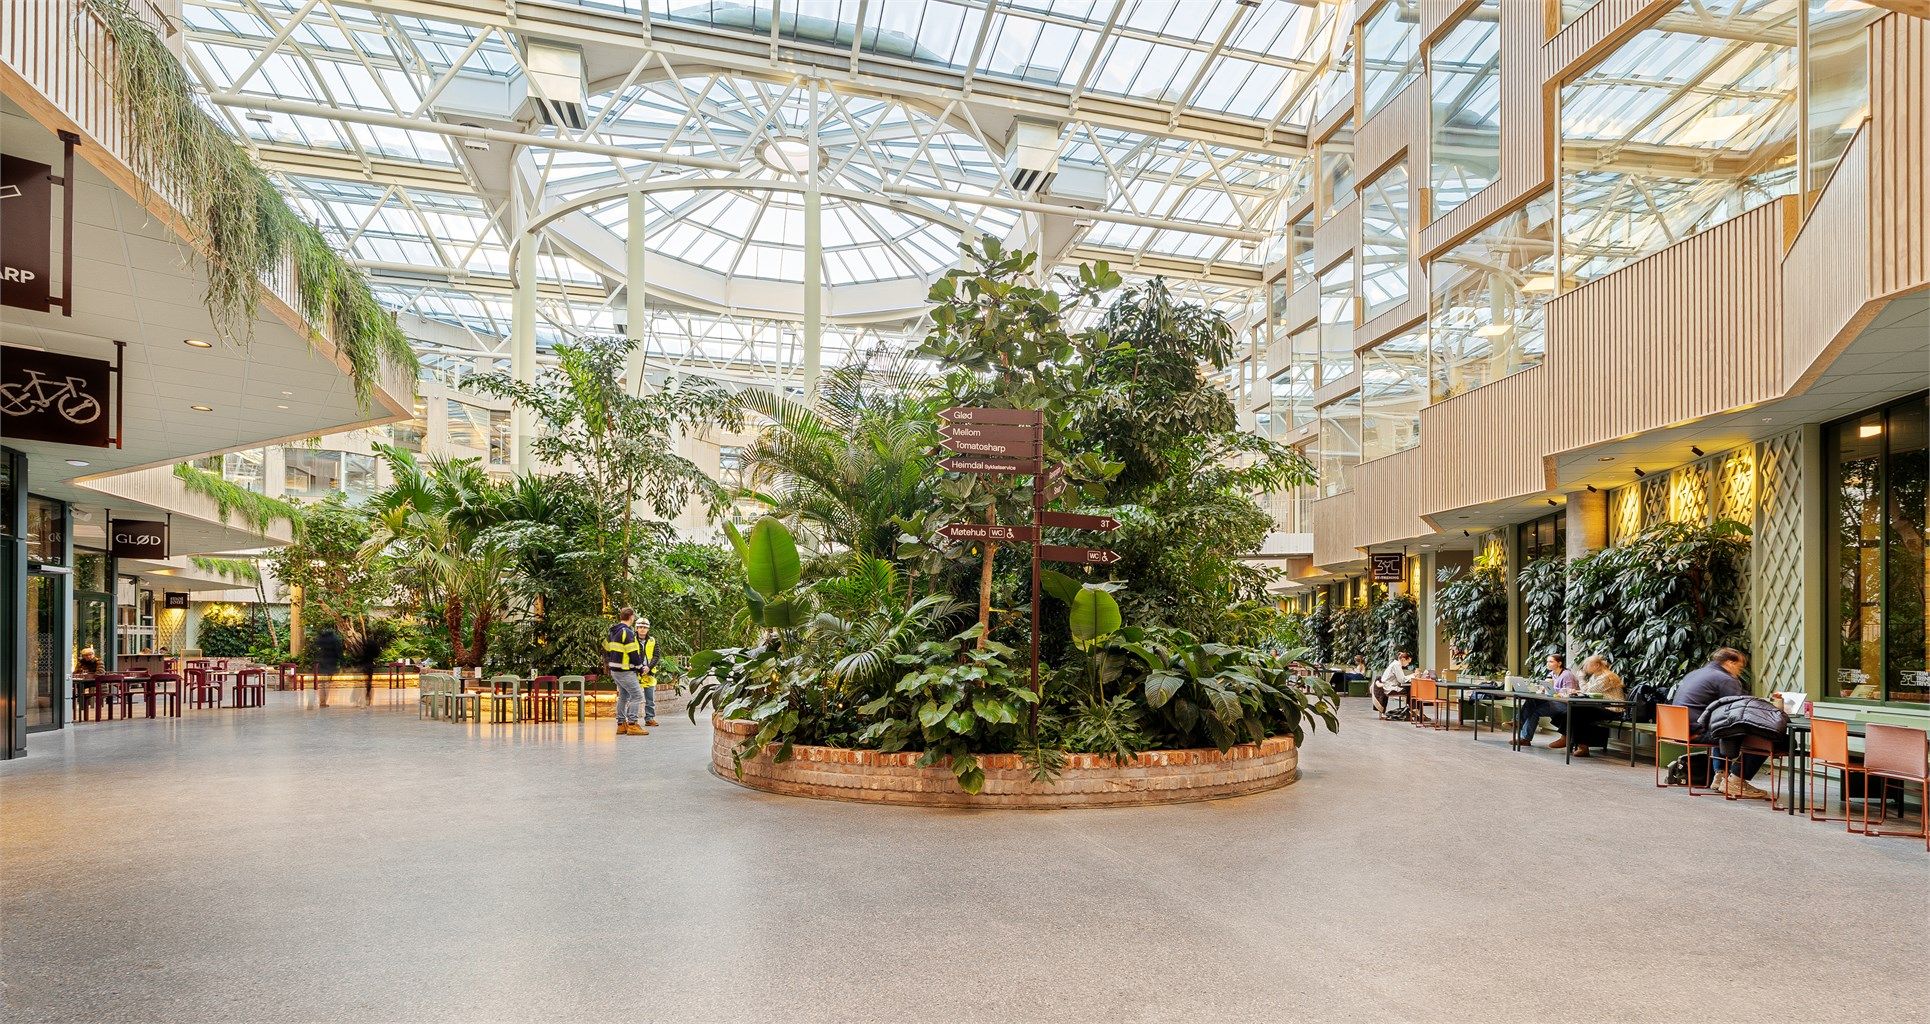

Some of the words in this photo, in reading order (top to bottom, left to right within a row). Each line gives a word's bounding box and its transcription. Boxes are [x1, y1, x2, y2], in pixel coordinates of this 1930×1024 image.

[953, 411, 973, 420] Glød
[952, 428, 981, 437] Mellom
[955, 440, 1006, 453] Tomatosharp
[951, 461, 984, 469] Heimdal
[1100, 520, 1110, 528] 3T
[950, 527, 987, 537] Møtehub
[991, 529, 1003, 537] WC
[115, 533, 161, 546] GLØD
[1089, 552, 1100, 560] WC
